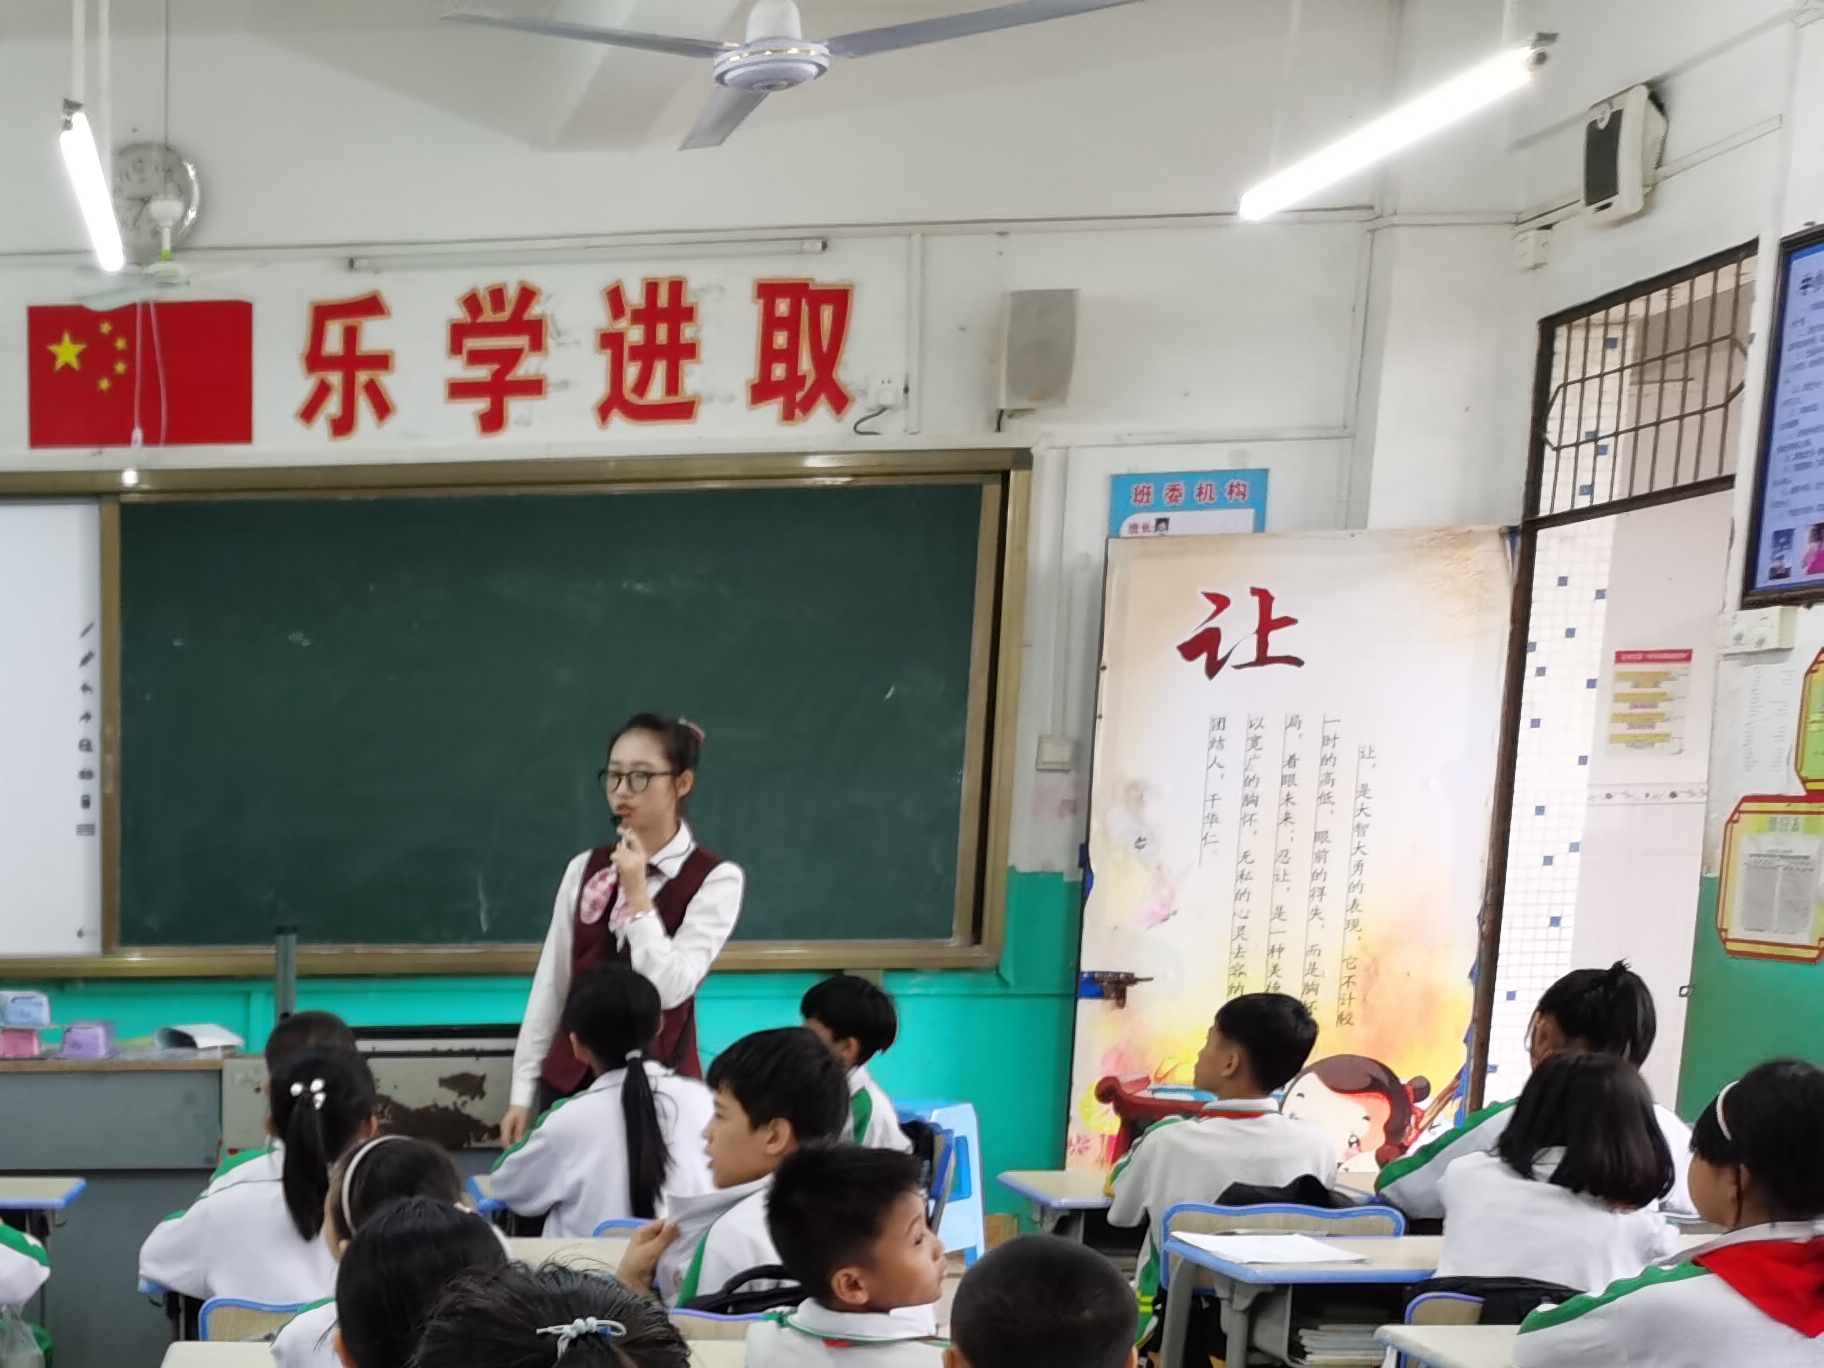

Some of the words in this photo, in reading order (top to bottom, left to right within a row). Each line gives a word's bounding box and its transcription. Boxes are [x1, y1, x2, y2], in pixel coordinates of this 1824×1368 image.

[295, 276, 856, 440] 乐学进取
[1176, 586, 1305, 681] 让
